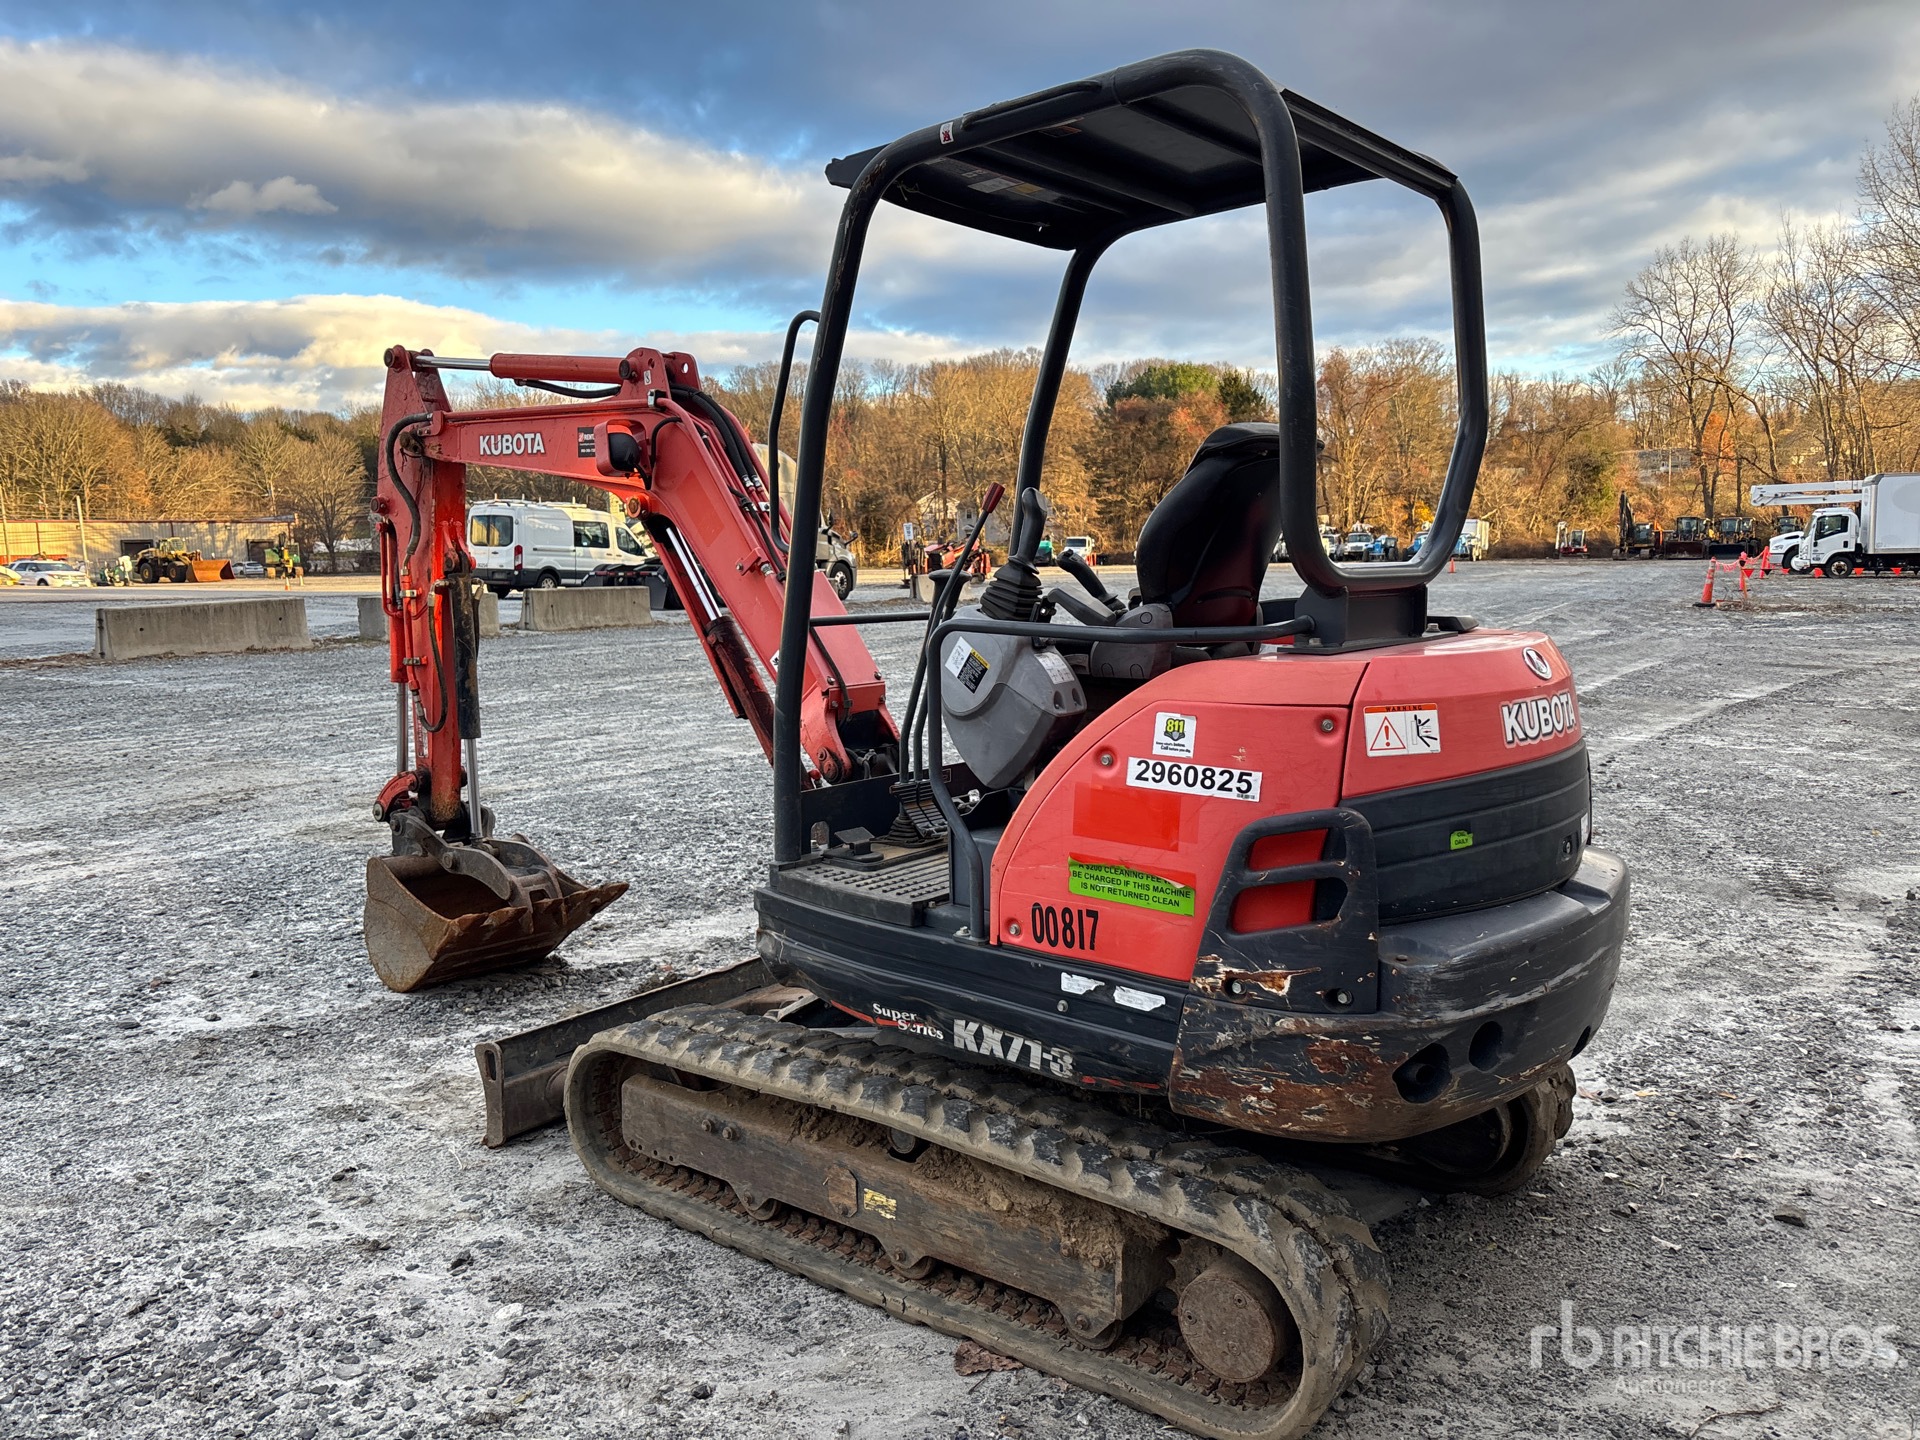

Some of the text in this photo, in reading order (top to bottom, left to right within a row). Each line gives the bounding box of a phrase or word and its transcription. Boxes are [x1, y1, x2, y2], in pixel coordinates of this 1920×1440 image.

[479, 432, 545, 456] KUBOTA
[1166, 718, 1185, 733] 811
[1502, 692, 1577, 744] KUBOTA
[1134, 759, 1253, 794] 2960825
[1072, 870, 1082, 879] BE
[1084, 872, 1122, 886] CHARGED
[1123, 879, 1131, 887] IF
[1133, 881, 1151, 892] THIS
[1152, 884, 1192, 899] MACHINE
[1103, 866, 1144, 880] CLEANING
[1145, 872, 1161, 883] FEE
[1080, 881, 1180, 908] IS NOT RETURNED CLEAN
[1031, 902, 1099, 951] 00817
[872, 1002, 917, 1021] Super
[953, 1019, 1074, 1079] KX71-3
